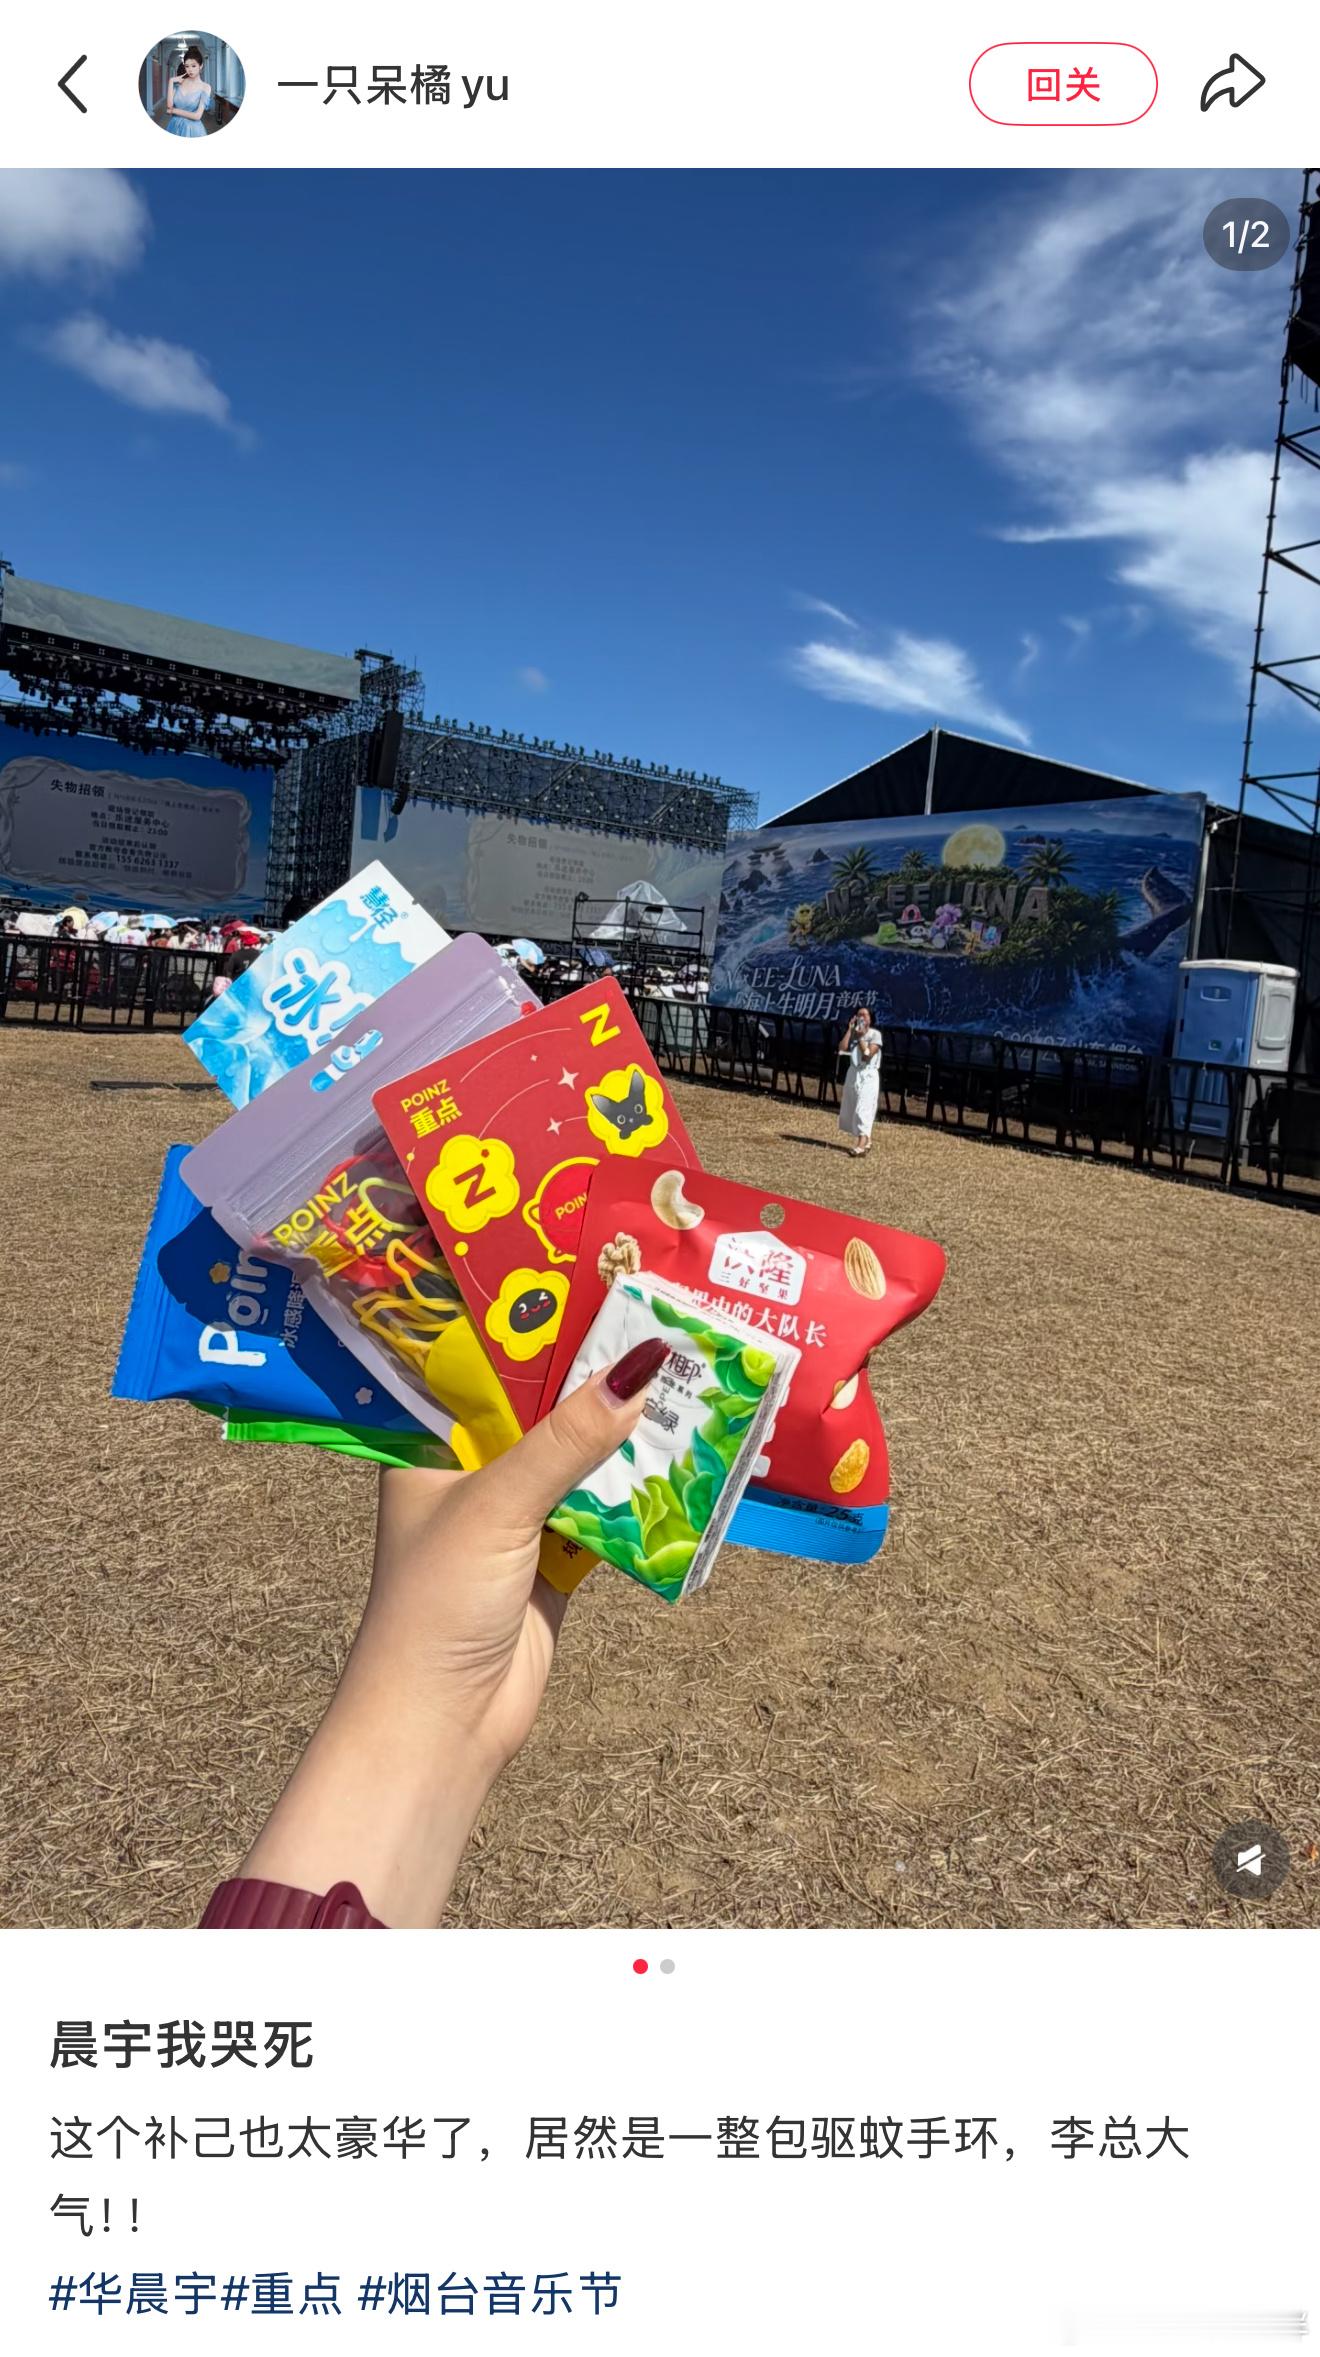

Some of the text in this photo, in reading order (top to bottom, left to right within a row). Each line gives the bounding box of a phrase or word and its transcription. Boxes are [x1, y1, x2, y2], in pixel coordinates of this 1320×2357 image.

[579, 1003, 621, 1047] Z
[400, 1079, 452, 1113] POINZ
[409, 1095, 463, 1139] 重点
[273, 1171, 359, 1247] POINZ
